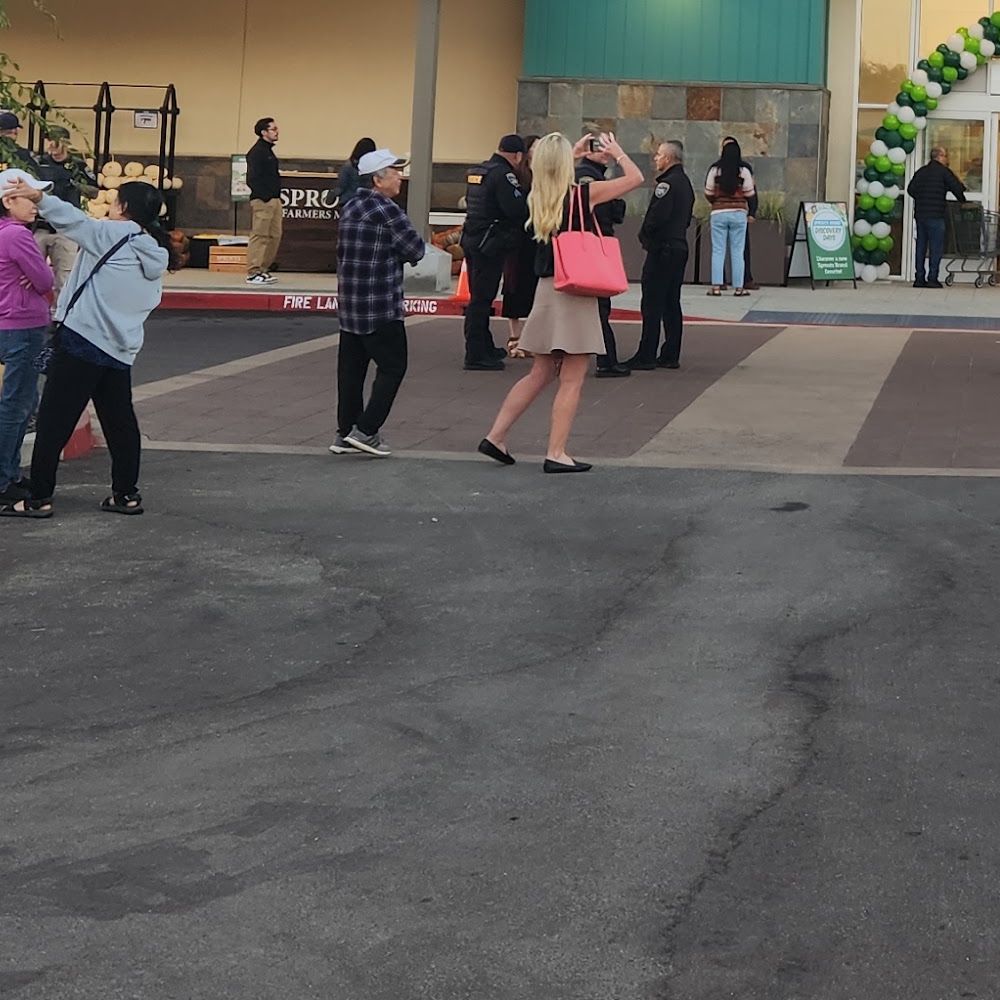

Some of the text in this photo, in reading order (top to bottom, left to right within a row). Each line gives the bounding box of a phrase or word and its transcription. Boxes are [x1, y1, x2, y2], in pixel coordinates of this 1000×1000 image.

[280, 188, 340, 209] SPRO
[282, 208, 332, 220] FARMERS
[283, 296, 338, 309] FIRE LAN
[402, 300, 438, 314] RKING
